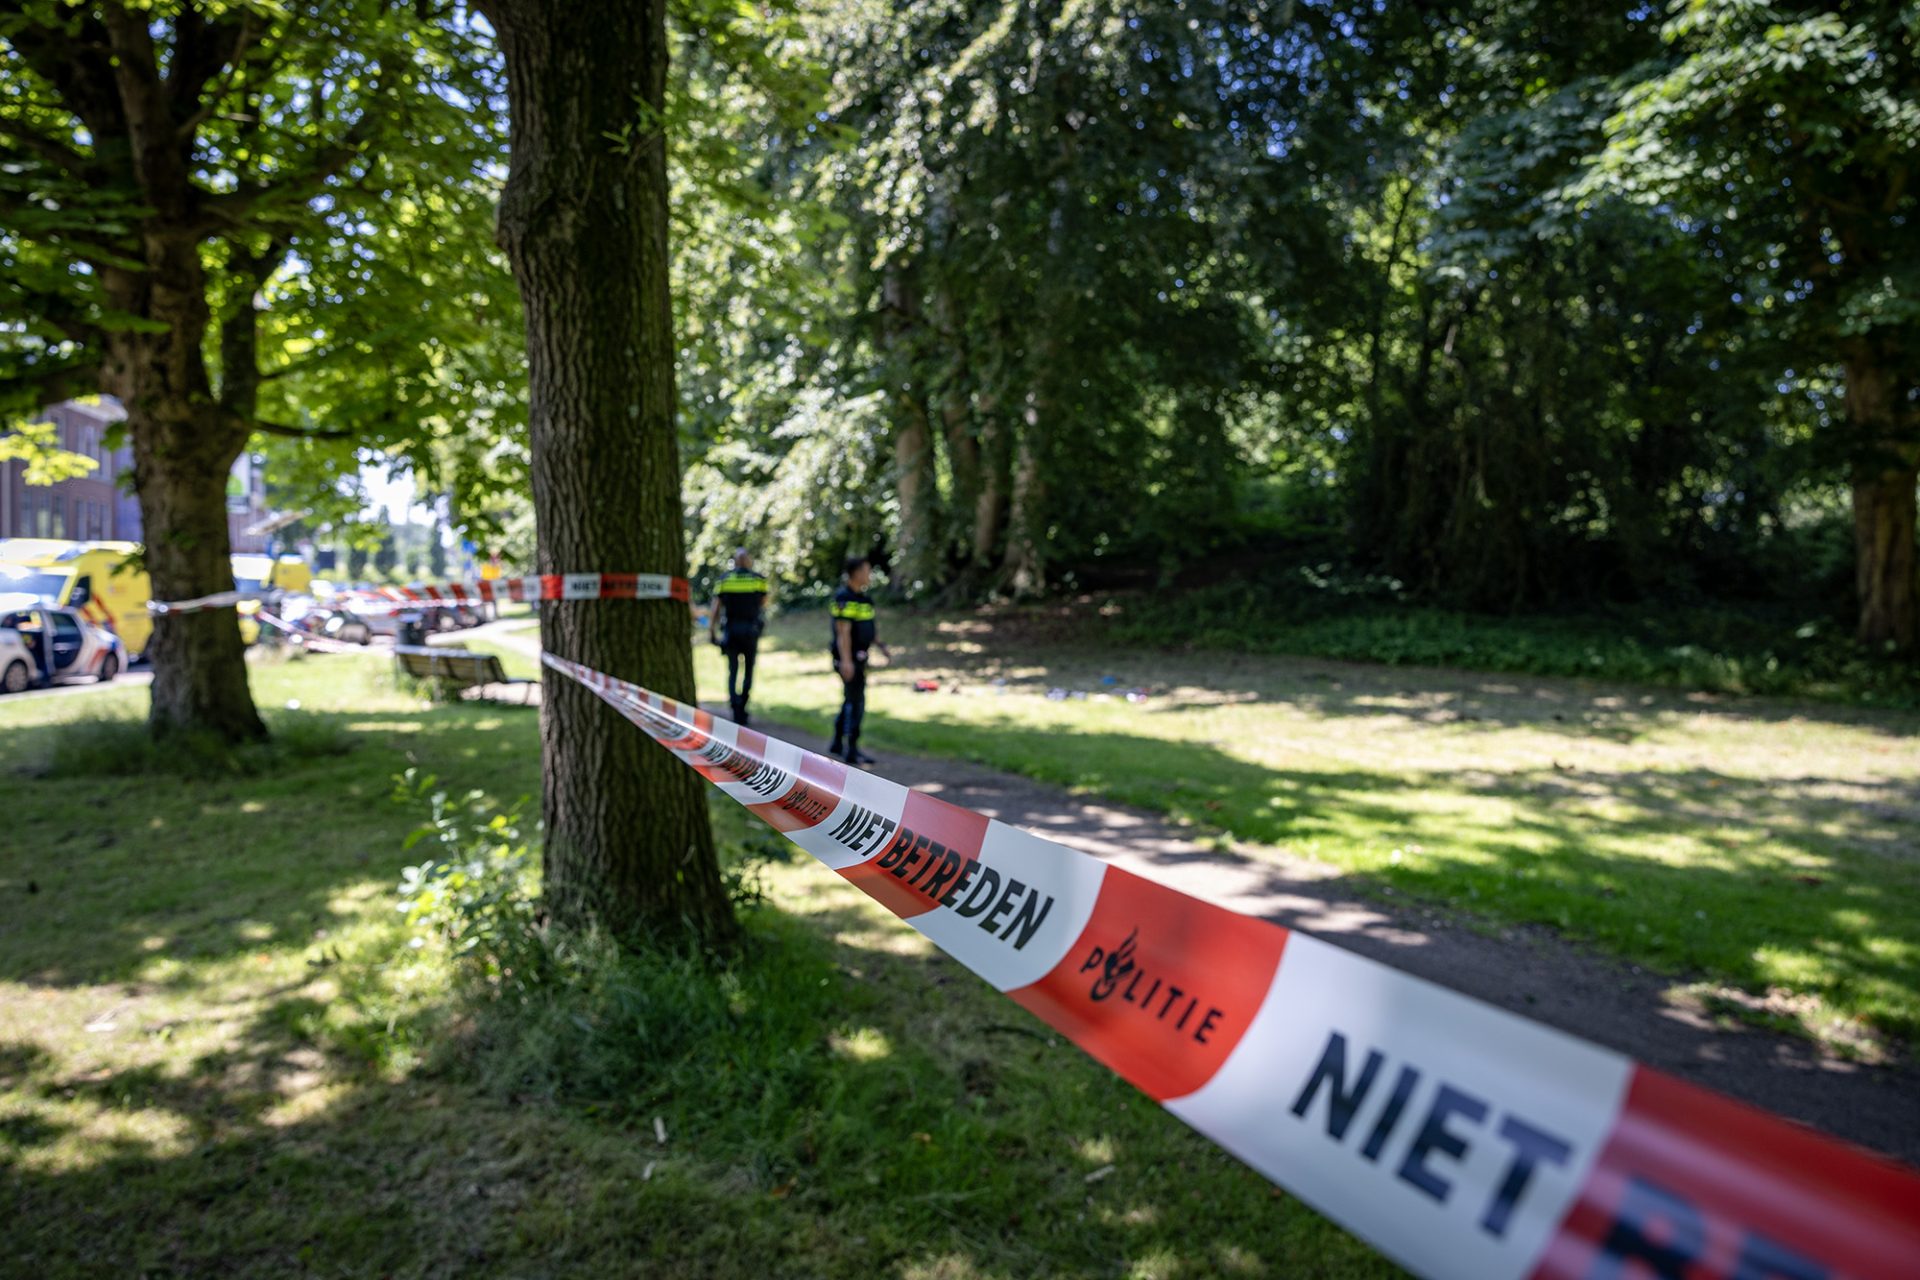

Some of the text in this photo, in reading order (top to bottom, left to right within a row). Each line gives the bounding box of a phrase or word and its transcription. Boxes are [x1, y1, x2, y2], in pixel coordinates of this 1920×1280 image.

[703, 741, 787, 796] NIET BETREDEN
[828, 803, 1054, 951] NIET BETREDEN
[1079, 930, 1224, 1045] POLITIE
[1288, 1027, 1578, 1243] NIET
